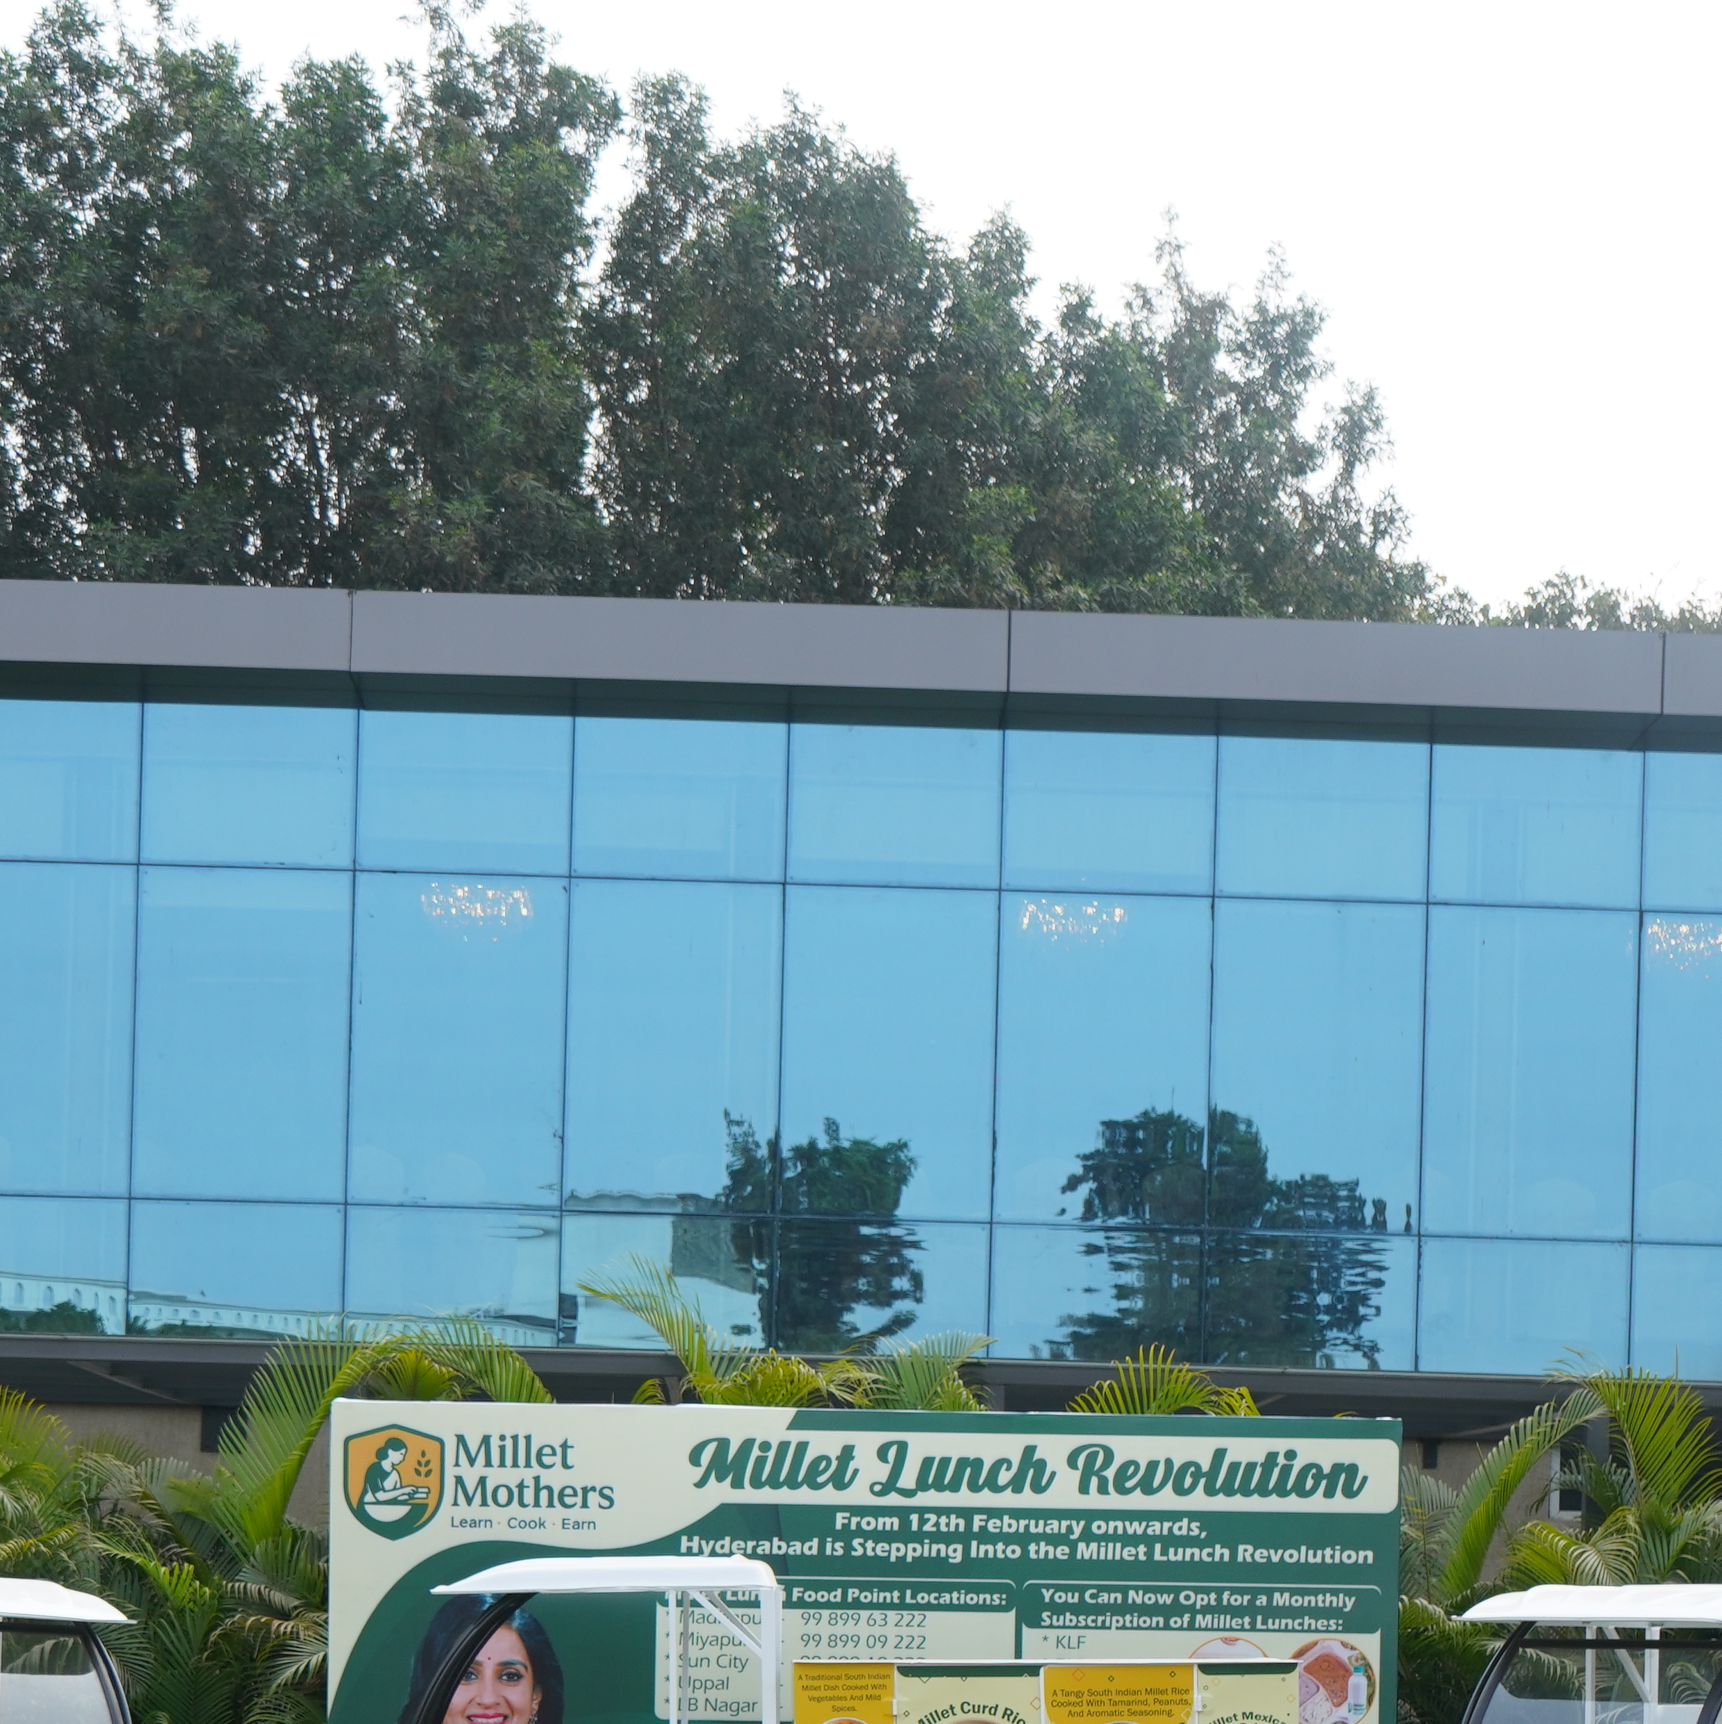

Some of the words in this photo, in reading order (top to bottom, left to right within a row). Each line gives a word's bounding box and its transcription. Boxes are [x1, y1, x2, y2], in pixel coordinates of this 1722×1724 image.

[453, 1434, 574, 1470] Millet
[688, 1437, 860, 1491] Millet
[869, 1440, 1056, 1498] Lunch
[1067, 1443, 1368, 1500] Revolution
[451, 1475, 615, 1509] Mothers
[451, 1516, 493, 1530] Learn
[507, 1517, 546, 1531] Cook
[561, 1518, 596, 1531] Earn
[835, 1512, 899, 1532] From
[908, 1513, 965, 1532] 12th
[973, 1514, 1085, 1539] February
[1091, 1516, 1208, 1540] onwards,
[680, 1535, 818, 1557] Hyderabad
[826, 1537, 843, 1555] is
[851, 1538, 963, 1563] Stepping
[970, 1540, 1021, 1559] Into
[1028, 1540, 1070, 1560] the
[1076, 1542, 1147, 1562] Millet
[1154, 1543, 1230, 1563] Lunch
[1237, 1544, 1374, 1565] Revolution
[792, 1587, 843, 1603] Food
[847, 1588, 899, 1603] Point
[904, 1589, 1007, 1605] Locations:
[1041, 1588, 1078, 1604] You
[1084, 1589, 1122, 1605] Can
[1127, 1590, 1173, 1606] Now
[1179, 1590, 1216, 1609] Opt
[1222, 1590, 1251, 1606] for
[1255, 1596, 1267, 1607] a
[1272, 1592, 1356, 1612] Monthly
[800, 1611, 823, 1626] 99
[828, 1612, 861, 1626] 899
[866, 1612, 889, 1627] 63
[893, 1613, 927, 1628] 222
[1041, 1611, 1163, 1631] Subscription
[1169, 1612, 1190, 1629] of
[1195, 1613, 1251, 1630] Millet
[1256, 1614, 1343, 1631] Lunches:
[1055, 1635, 1087, 1650] KLF
[716, 1654, 749, 1673] City
[678, 1675, 729, 1694] Uppal
[705, 1698, 758, 1717] Nagar
[960, 1701, 998, 1716] Curd
